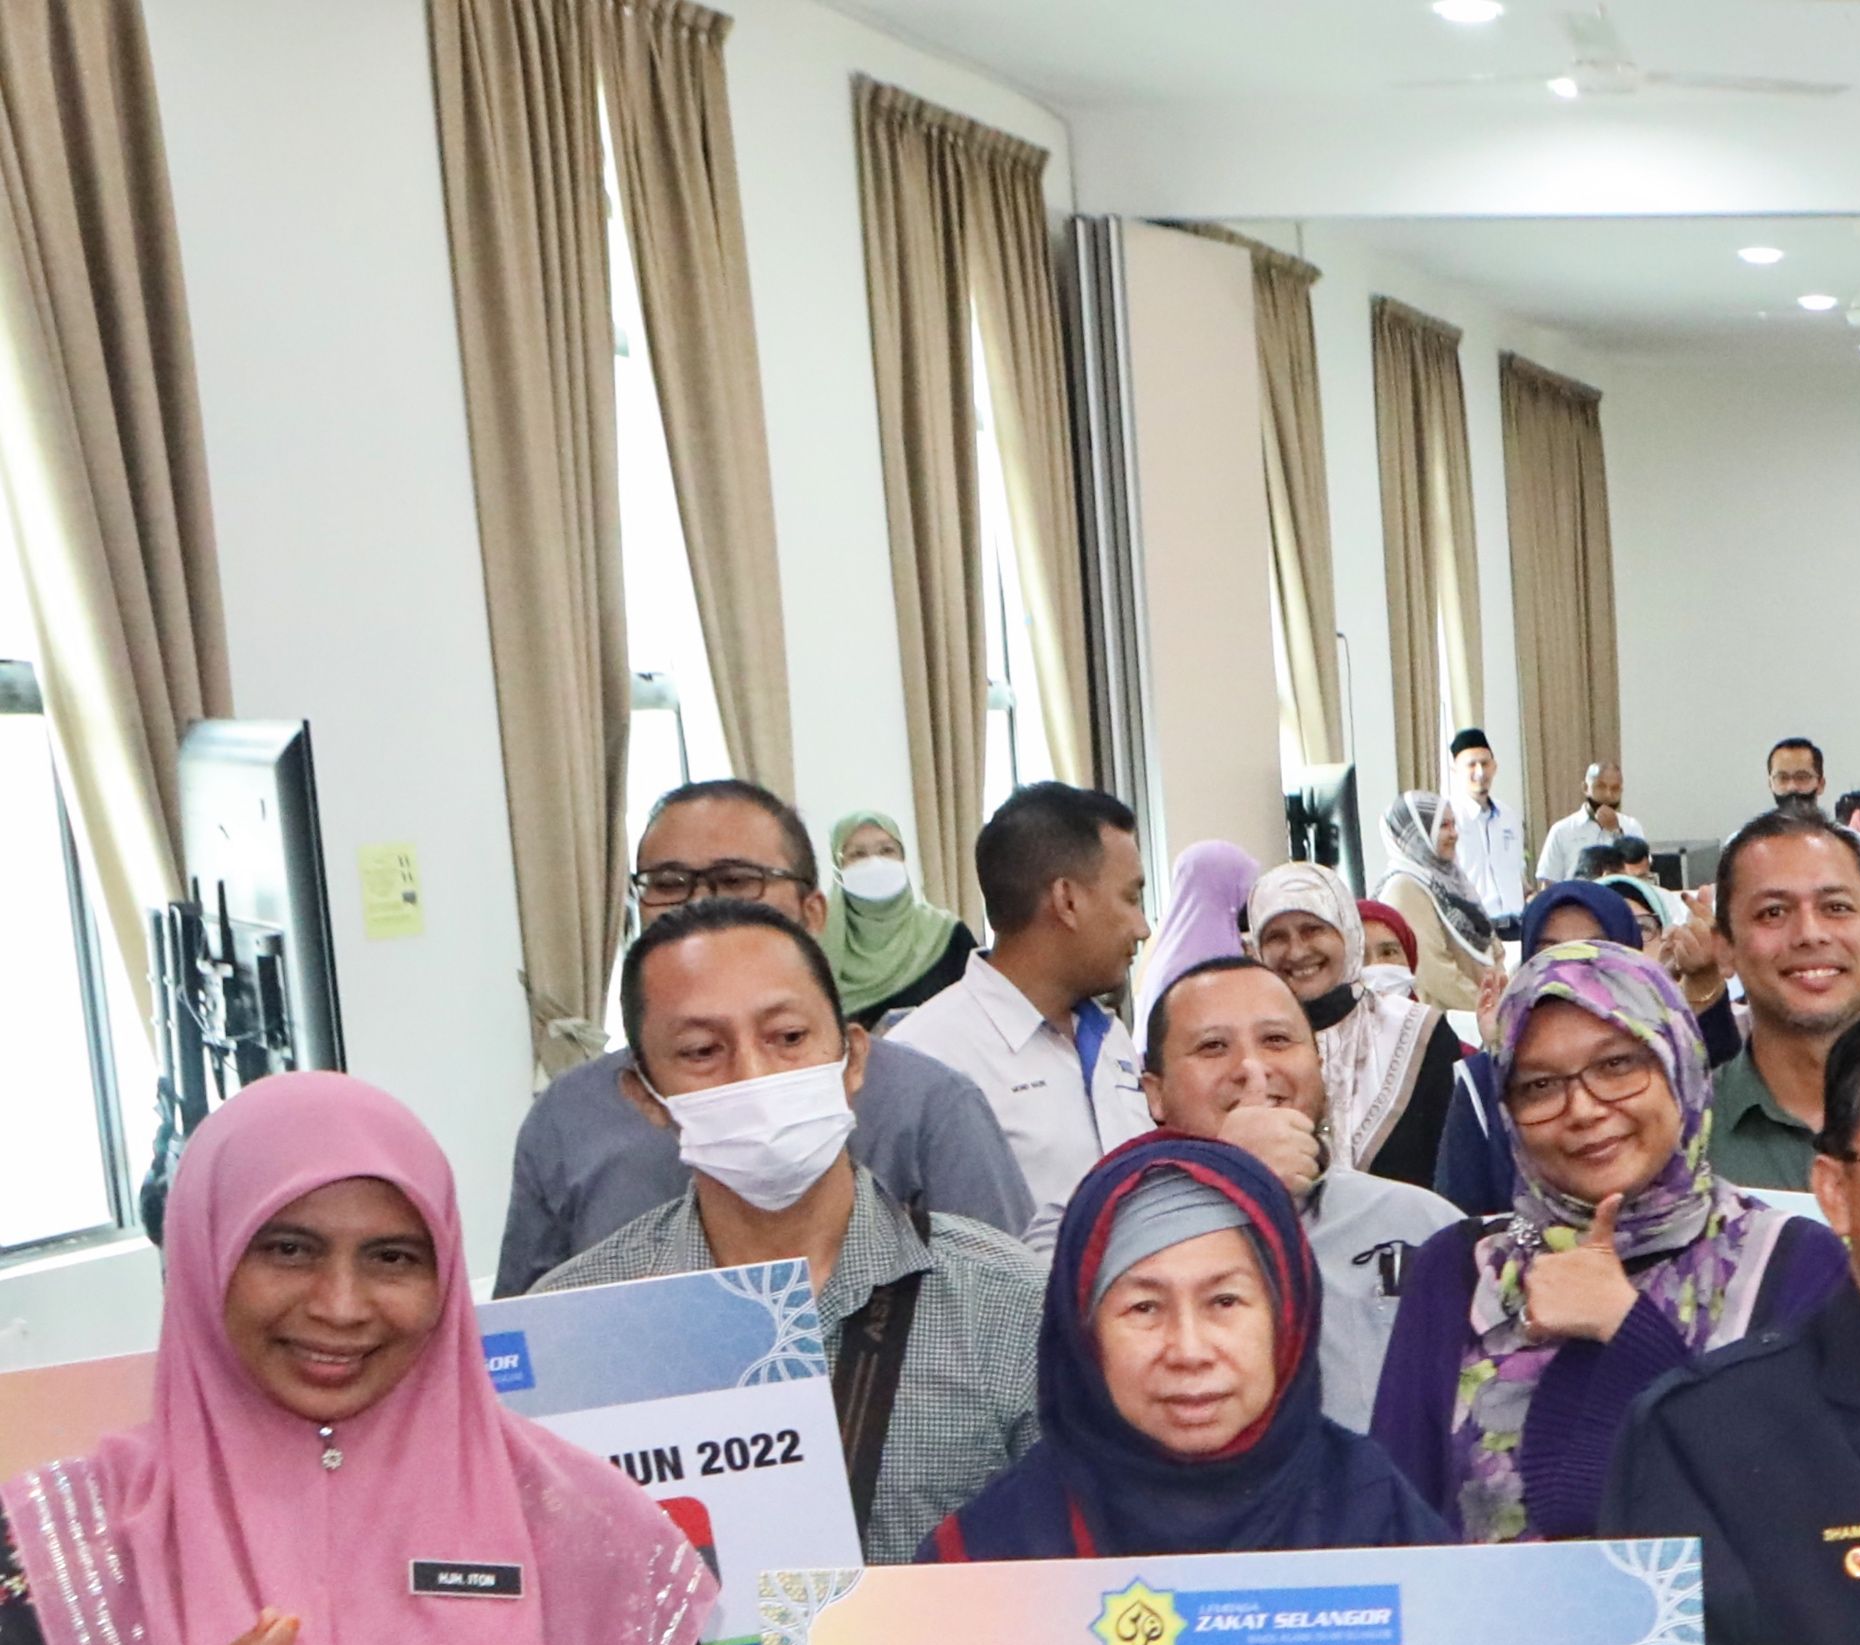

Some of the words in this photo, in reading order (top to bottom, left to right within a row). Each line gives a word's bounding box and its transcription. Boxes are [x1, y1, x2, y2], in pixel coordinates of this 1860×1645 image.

[698, 1430, 803, 1475] 2022
[1194, 1611, 1269, 1633] ZAKAT
[1273, 1607, 1392, 1630] SELANGOR
